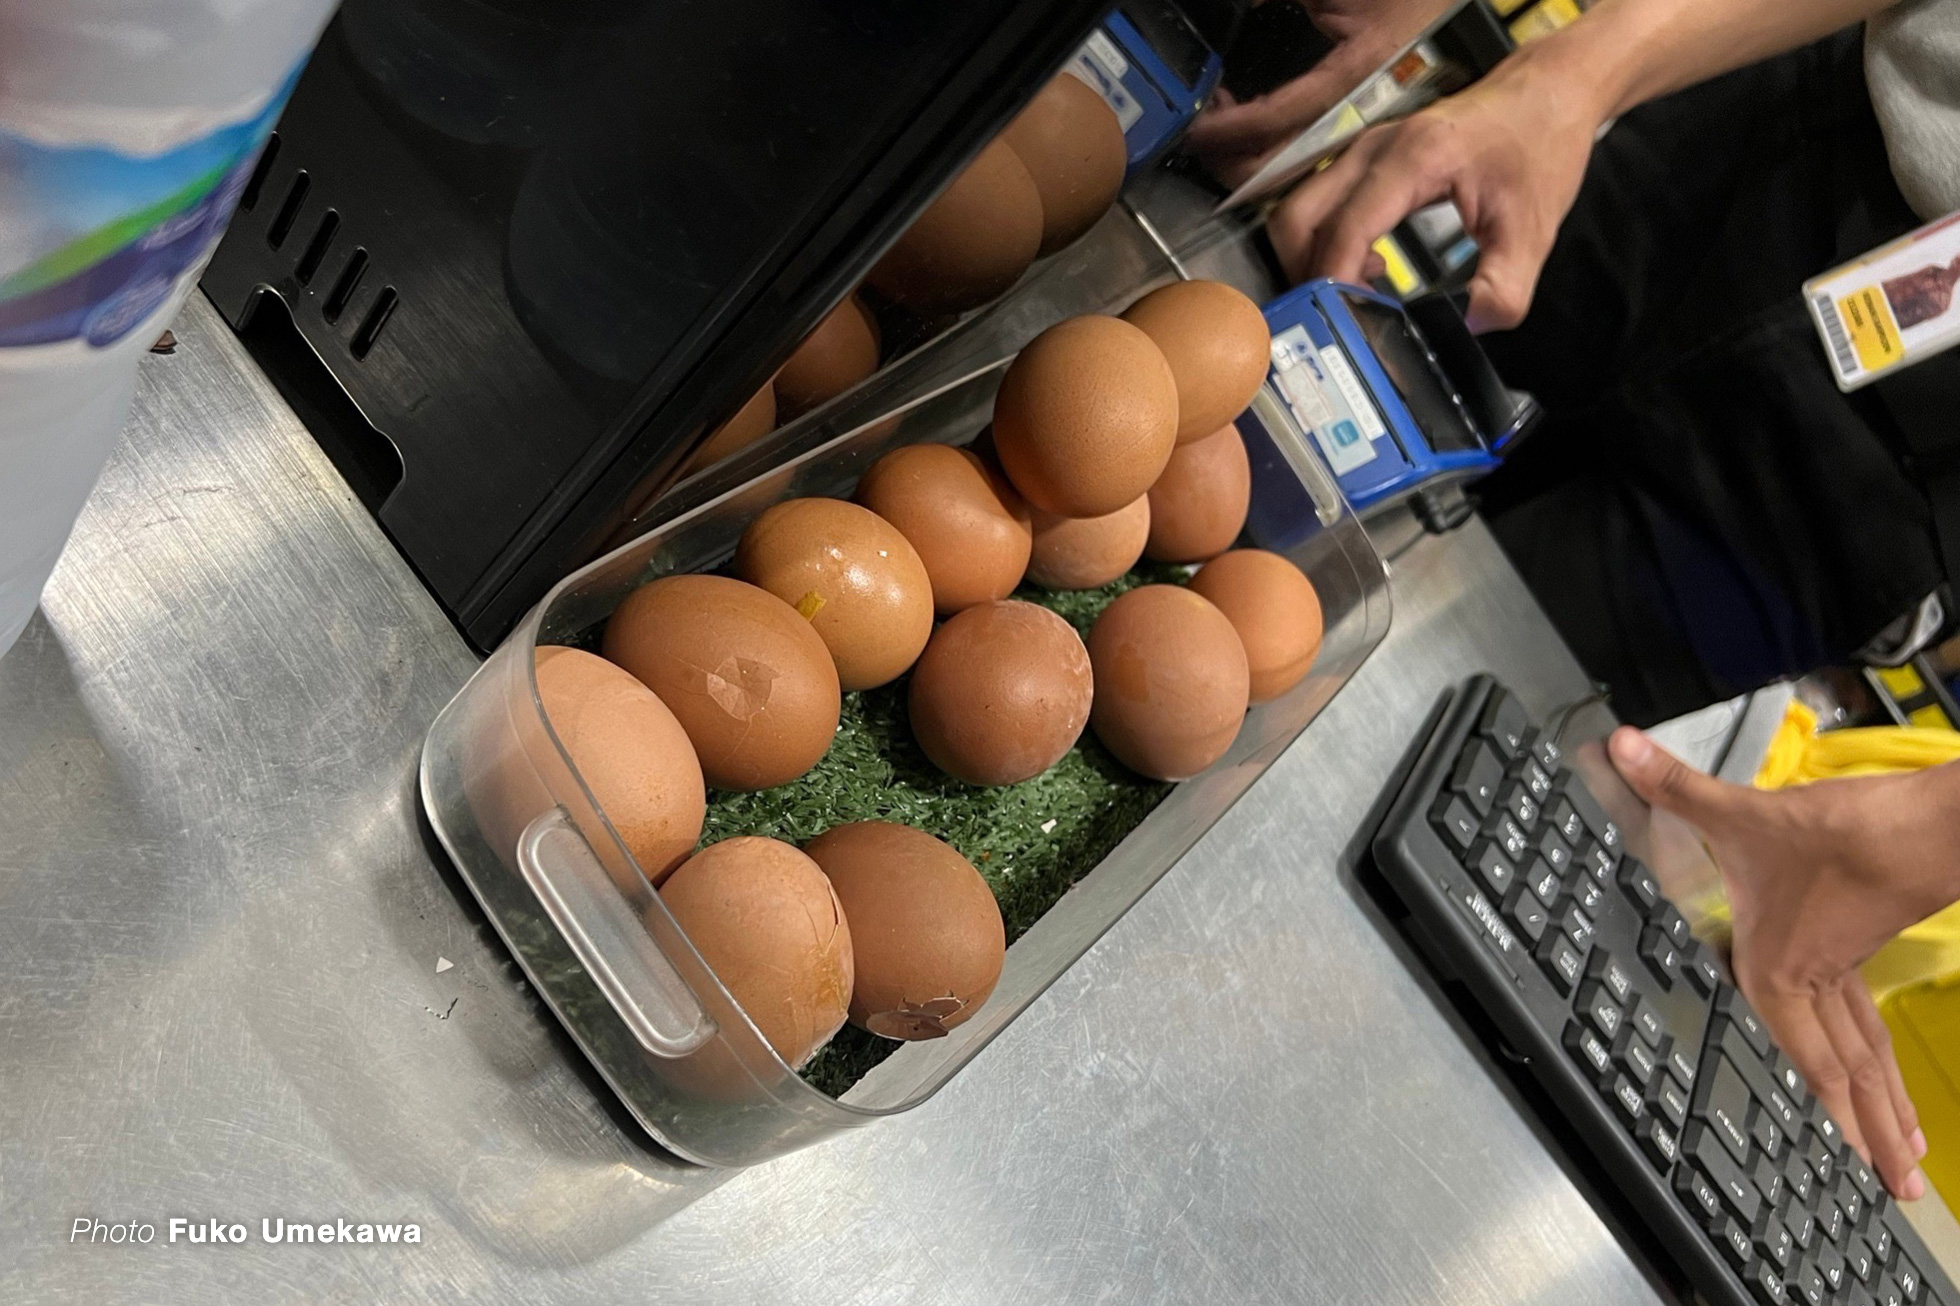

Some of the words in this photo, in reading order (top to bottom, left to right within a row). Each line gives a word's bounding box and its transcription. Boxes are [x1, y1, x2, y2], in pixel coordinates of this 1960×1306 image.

[1604, 831, 1614, 845] 0
[1538, 881, 1548, 896] 8
[1573, 929, 1583, 942] 7
[1700, 1186, 1713, 1206] F12
[1734, 1232, 1746, 1251] F11
[1767, 1275, 1780, 1295] F10
[1903, 1273, 1913, 1294] M
